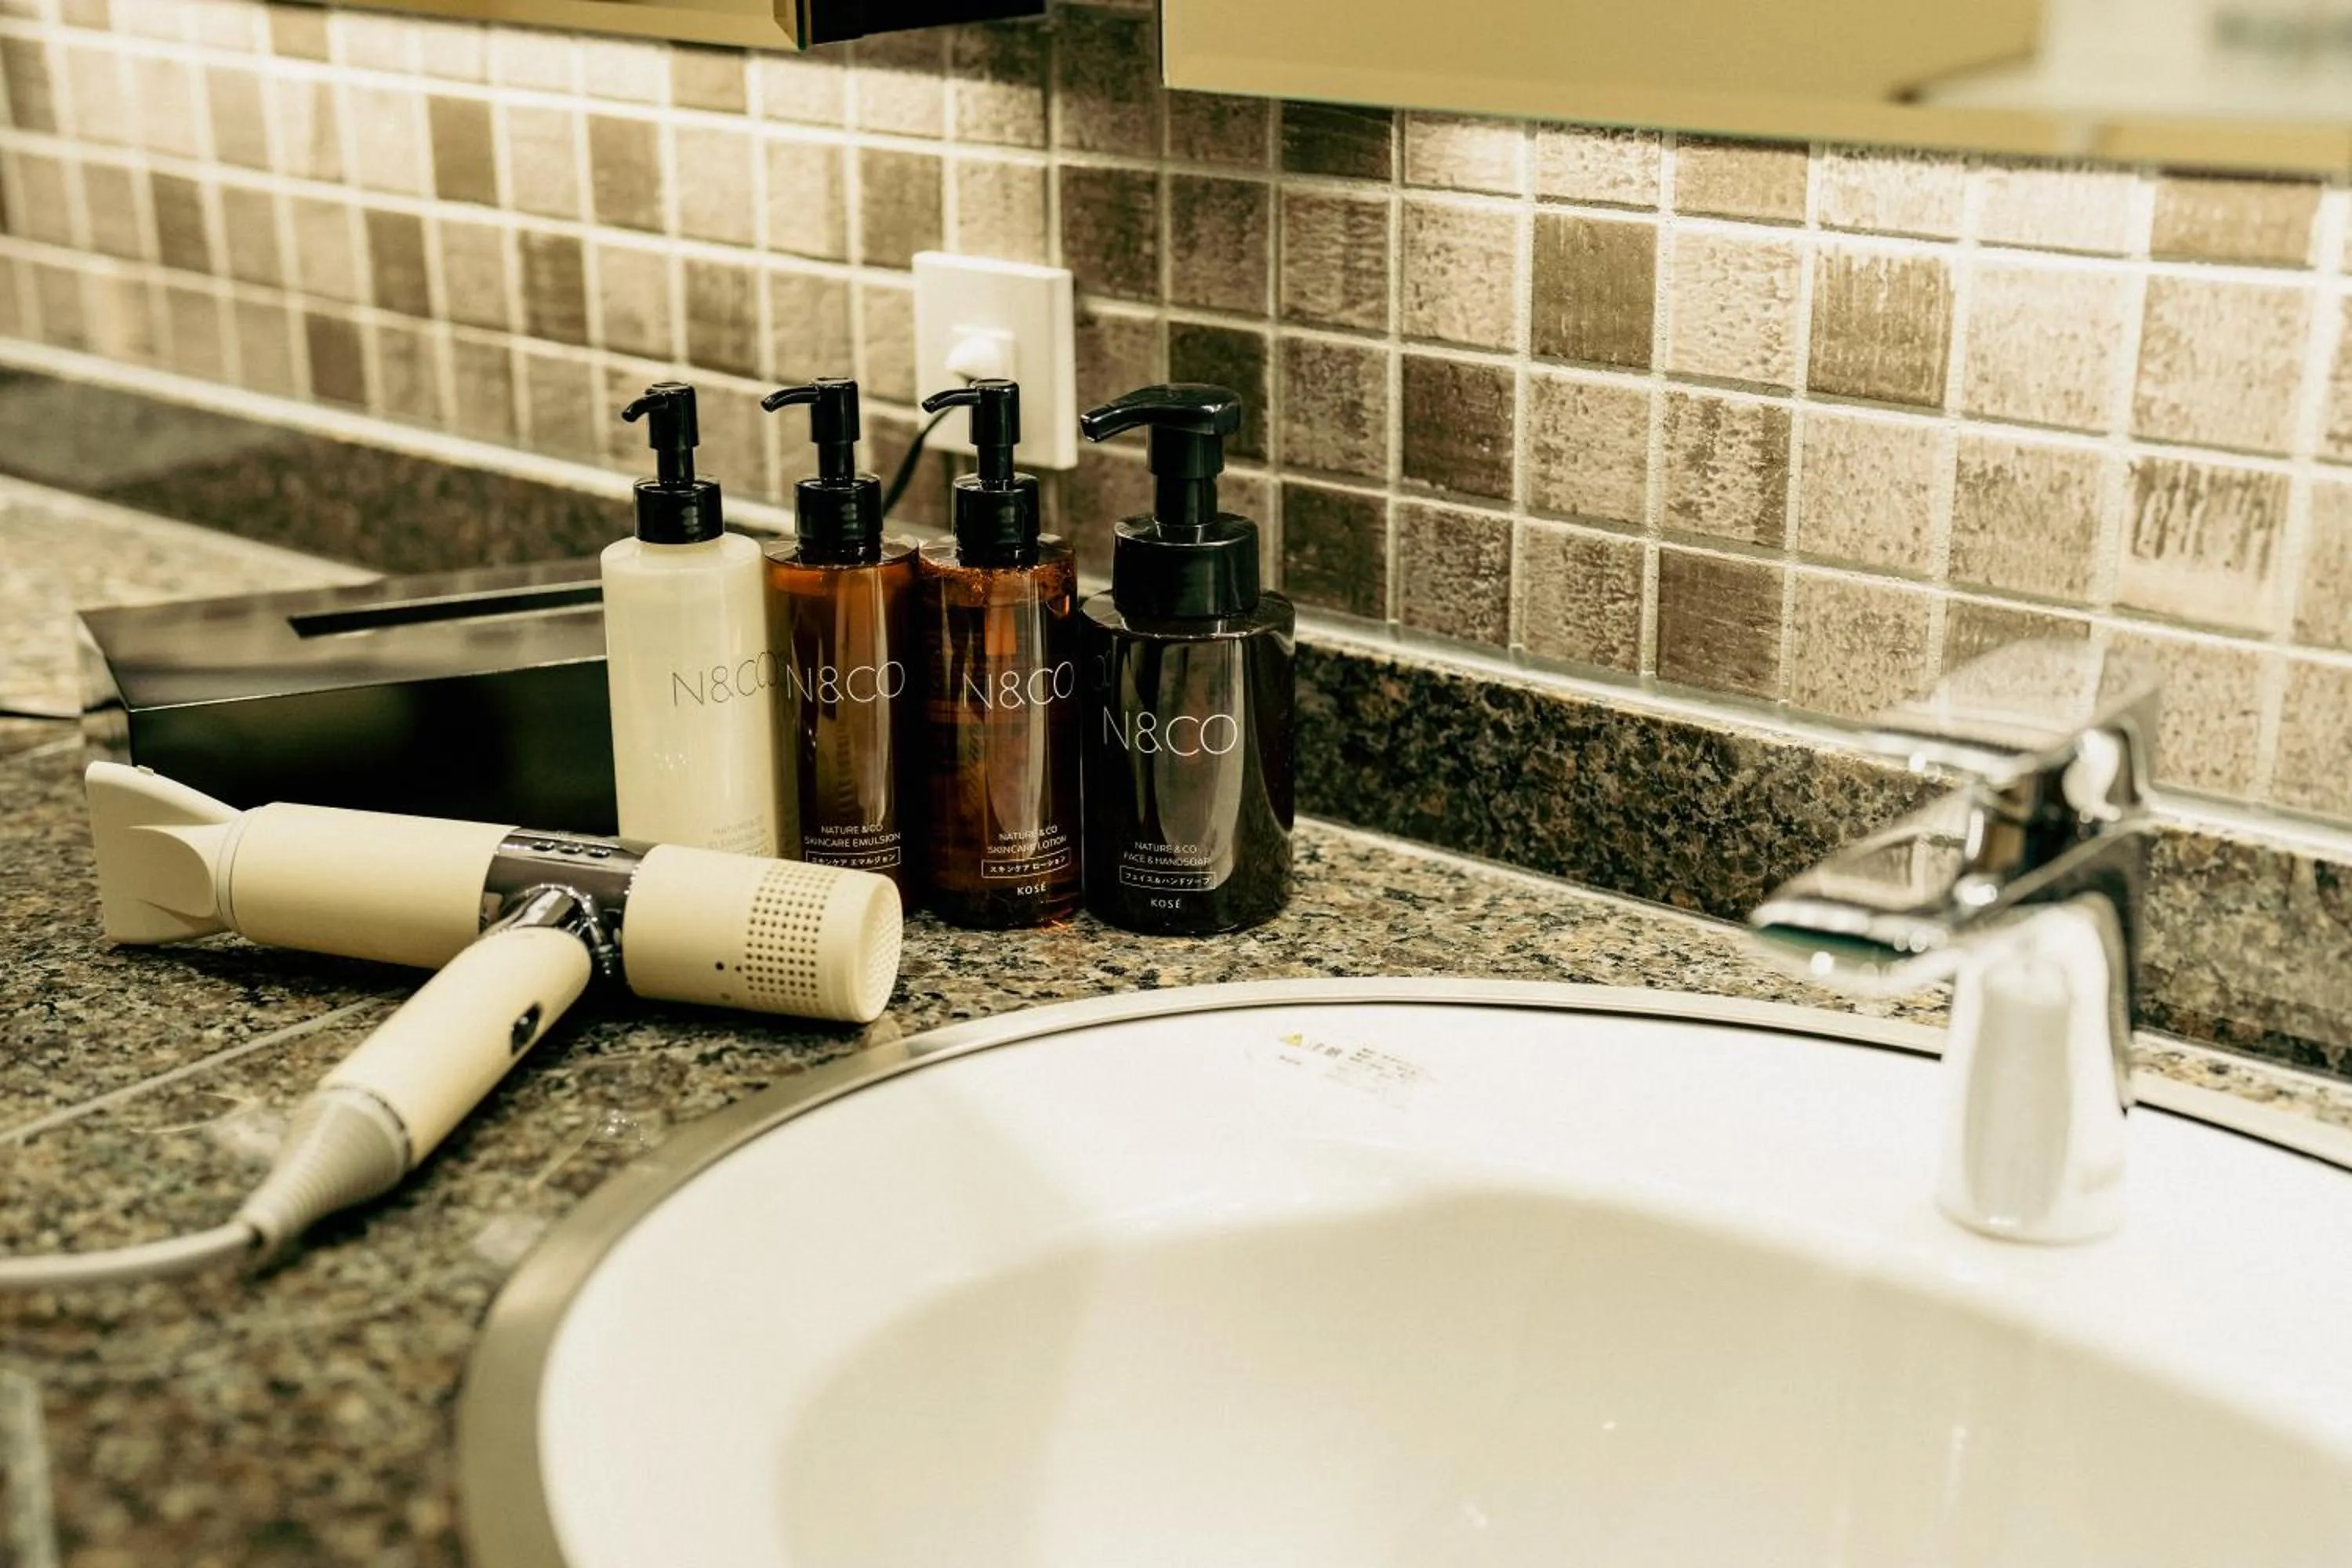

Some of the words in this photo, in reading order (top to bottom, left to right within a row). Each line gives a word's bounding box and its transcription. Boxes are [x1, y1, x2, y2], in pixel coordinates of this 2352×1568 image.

[786, 661, 906, 703] N&CO
[963, 661, 1075, 710] N&CO
[1103, 705, 1237, 757] N&CO
[821, 825, 860, 835] NATURE
[804, 835, 851, 848] SKINCARE
[852, 832, 901, 848] EMULSION
[1036, 834, 1067, 851] LOTION
[1134, 841, 1173, 854] NATURE
[1123, 851, 1145, 863] FACE
